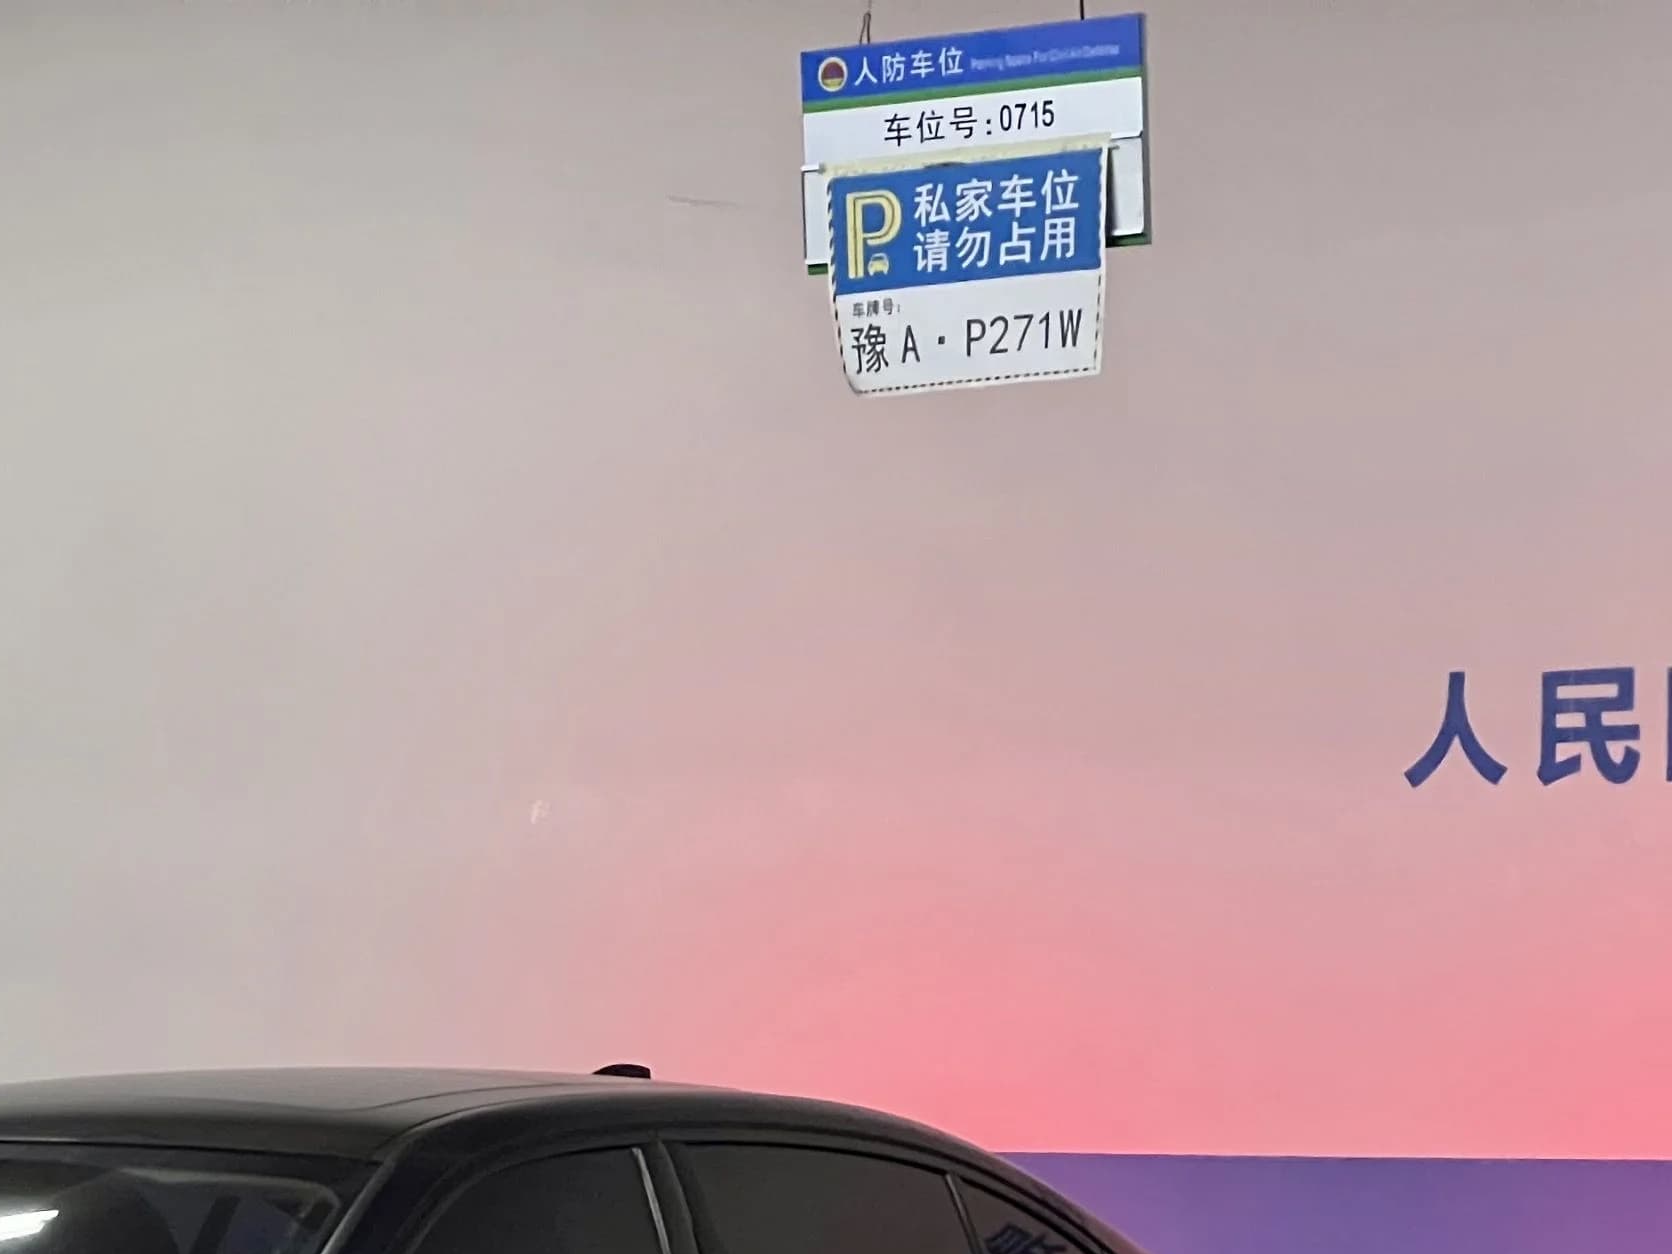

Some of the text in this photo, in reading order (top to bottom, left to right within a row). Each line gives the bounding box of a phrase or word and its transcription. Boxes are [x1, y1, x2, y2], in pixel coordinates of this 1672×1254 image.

[854, 47, 964, 87] 人防车位
[884, 100, 1056, 147] 车位号:0715
[913, 169, 1080, 229] 私家车位
[913, 217, 1077, 274] 请勿占用
[1403, 666, 1672, 789] 人民
